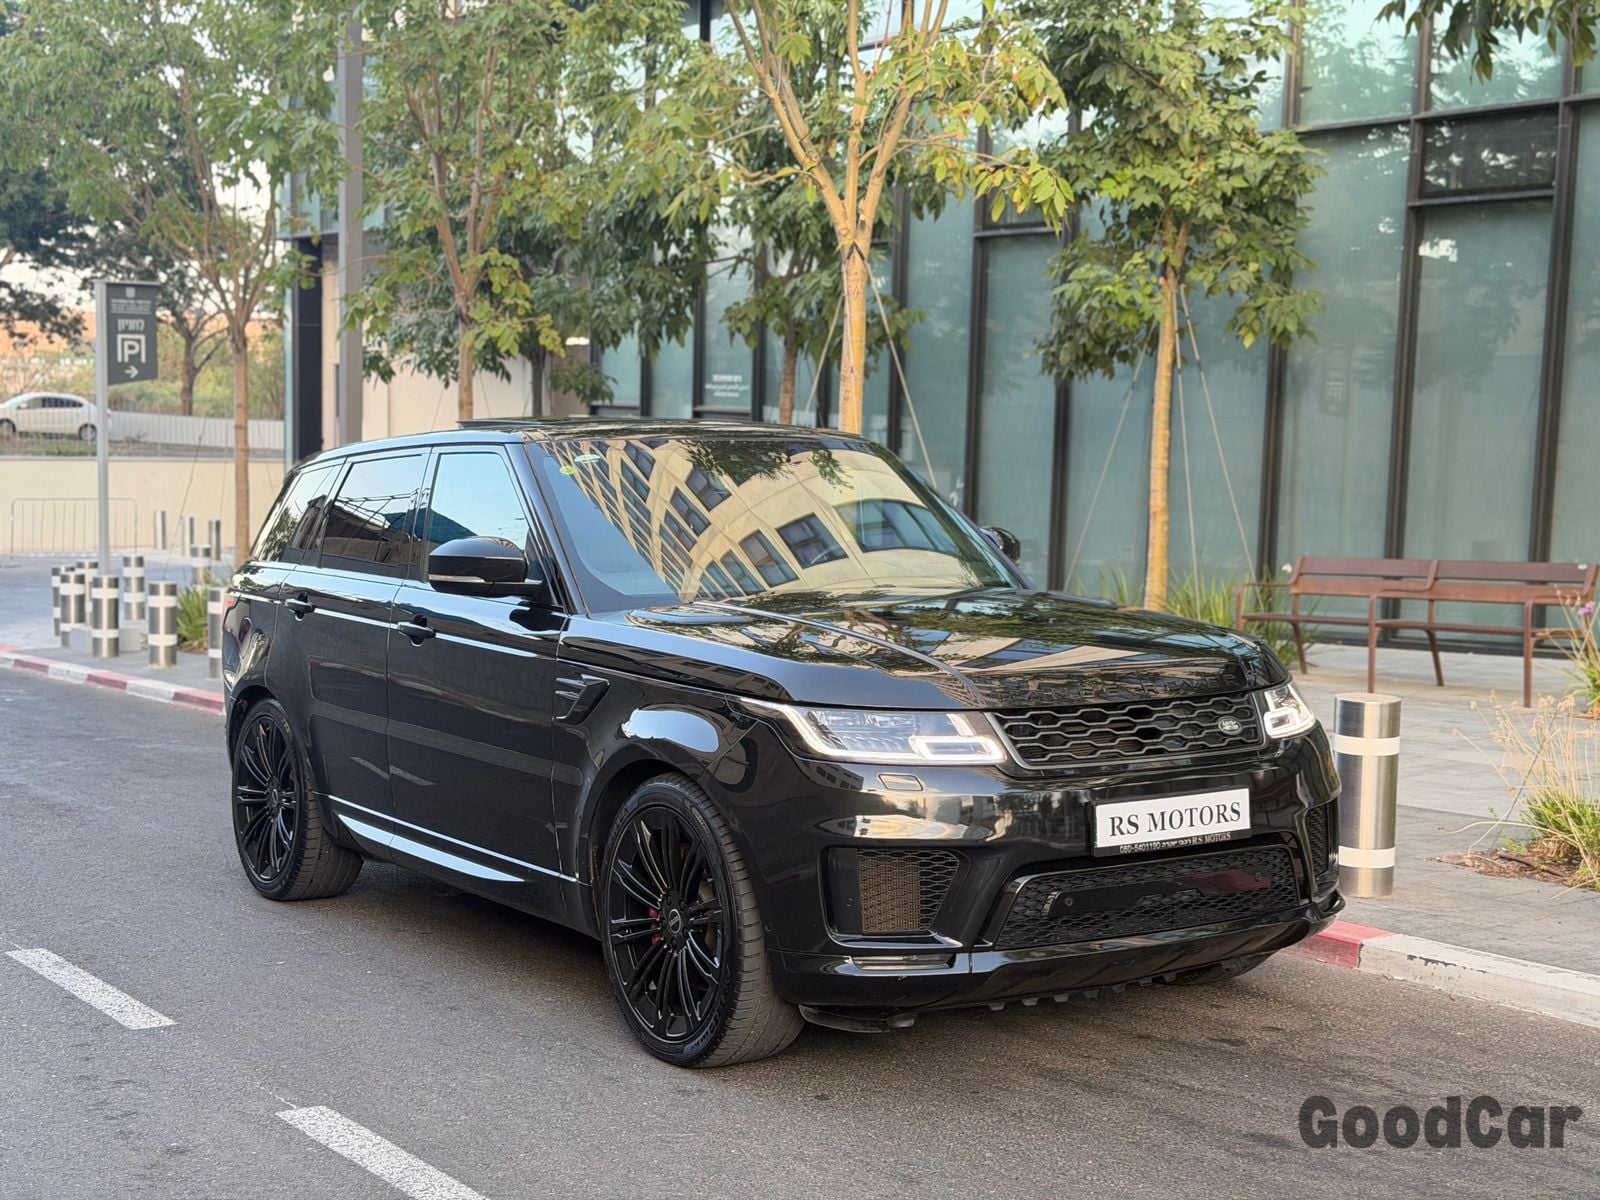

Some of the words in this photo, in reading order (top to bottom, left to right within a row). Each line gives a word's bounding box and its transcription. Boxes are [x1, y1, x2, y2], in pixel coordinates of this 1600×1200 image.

[123, 340, 140, 363] P
[1109, 813, 1140, 837] RS
[1146, 801, 1242, 833] MOTORS
